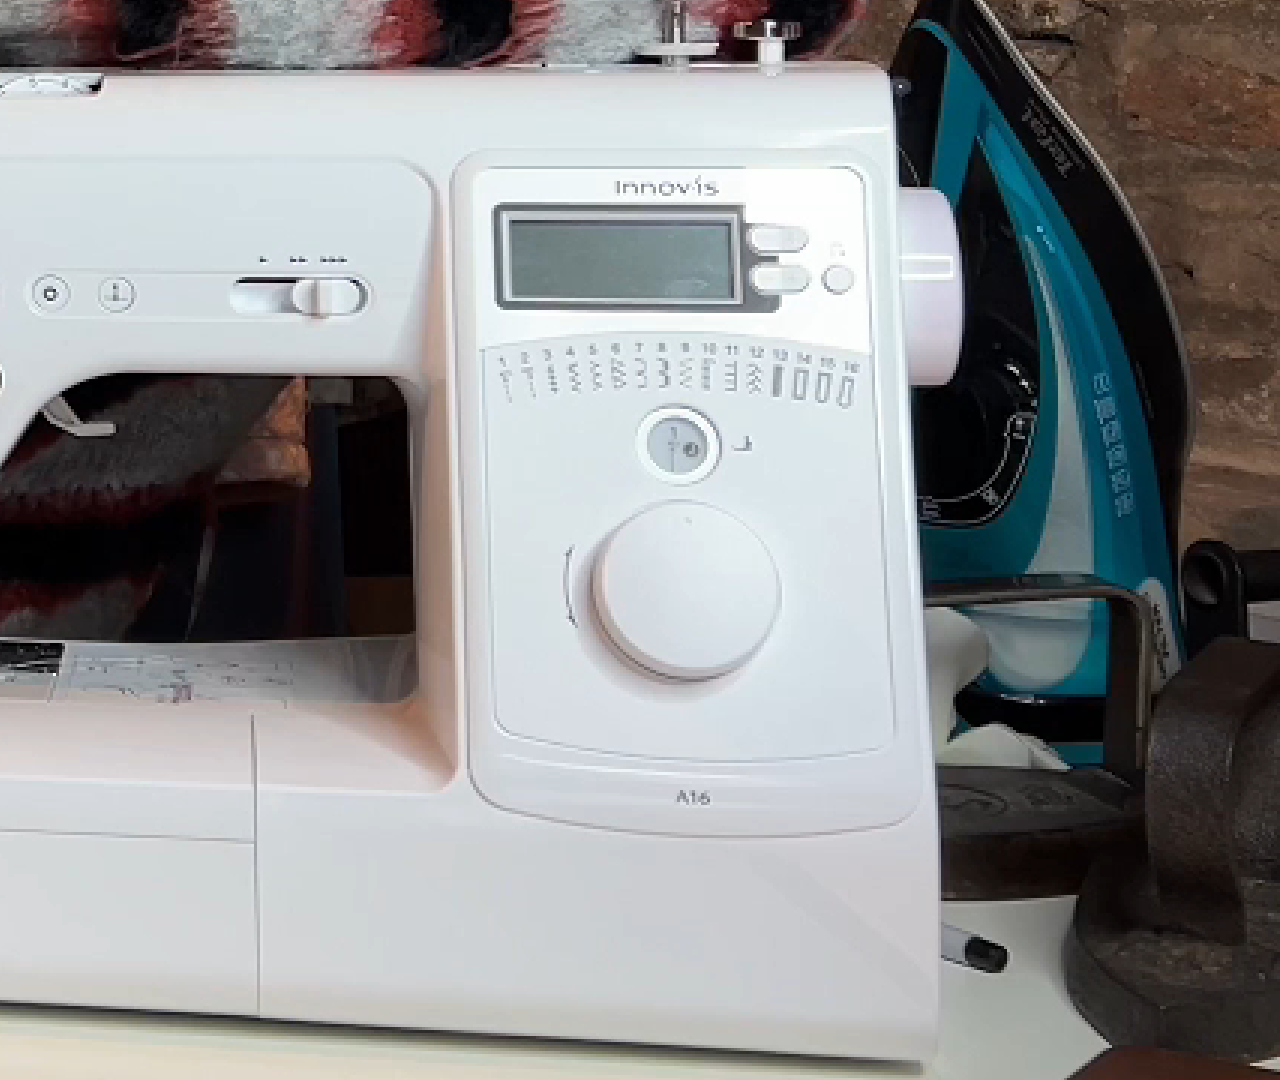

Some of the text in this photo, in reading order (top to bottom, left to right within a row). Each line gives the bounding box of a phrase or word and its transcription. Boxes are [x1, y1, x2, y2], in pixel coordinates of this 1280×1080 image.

[701, 343, 717, 355] 10
[725, 345, 739, 356] 11
[749, 346, 765, 358] 12
[772, 349, 788, 362] 13
[796, 352, 812, 364] 14
[676, 789, 711, 806] A16
